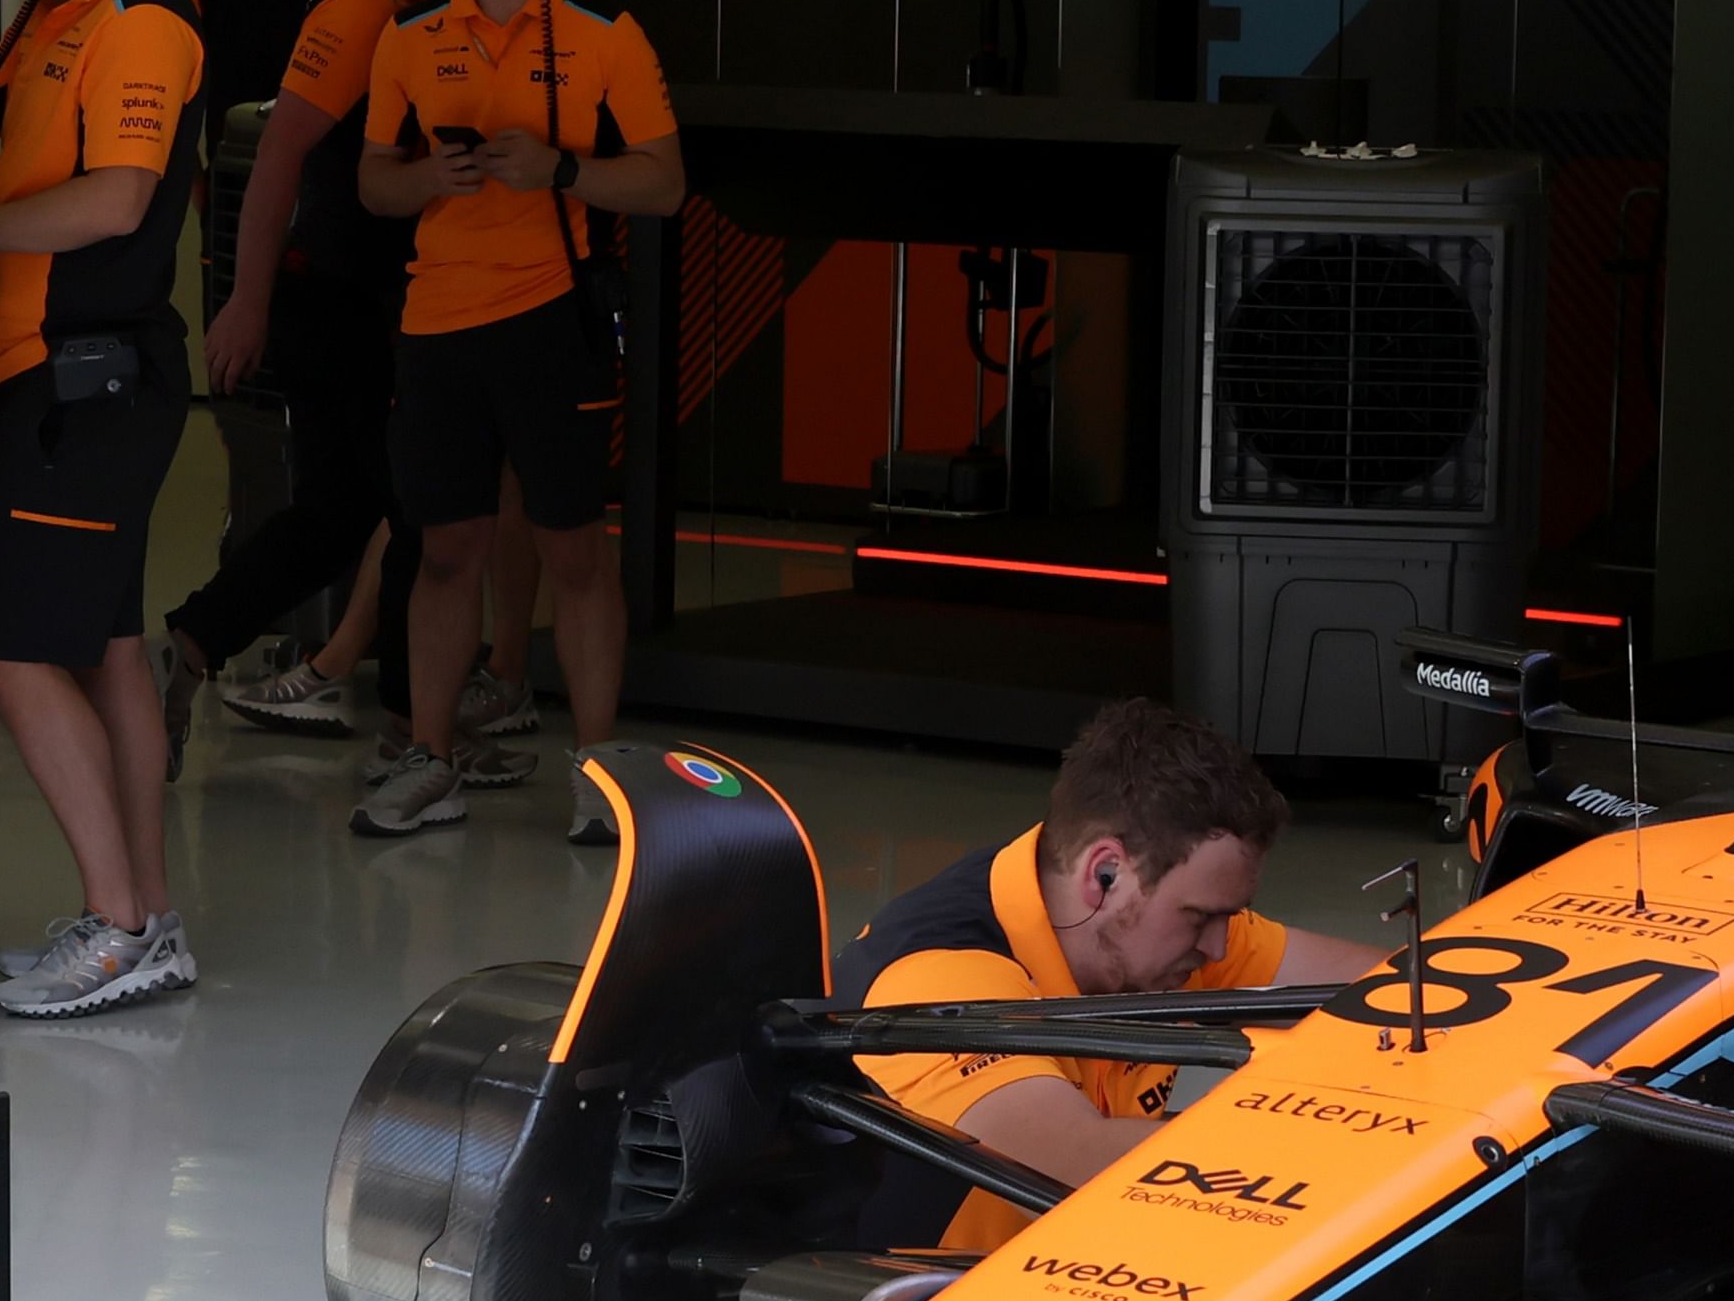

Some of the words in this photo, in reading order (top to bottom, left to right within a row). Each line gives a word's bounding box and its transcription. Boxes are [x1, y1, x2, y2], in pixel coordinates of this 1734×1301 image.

[1417, 661, 1491, 698] Medallia
[1513, 913, 1567, 931] FOR
[1574, 917, 1621, 936] THE
[1631, 925, 1697, 945] STAY
[1548, 894, 1714, 931] Hilton
[1322, 937, 1719, 1069] 81
[1234, 1087, 1430, 1137] alteryx
[1138, 1160, 1319, 1212] DELL
[1120, 1186, 1289, 1228] Technologies
[1045, 1283, 1065, 1296] by
